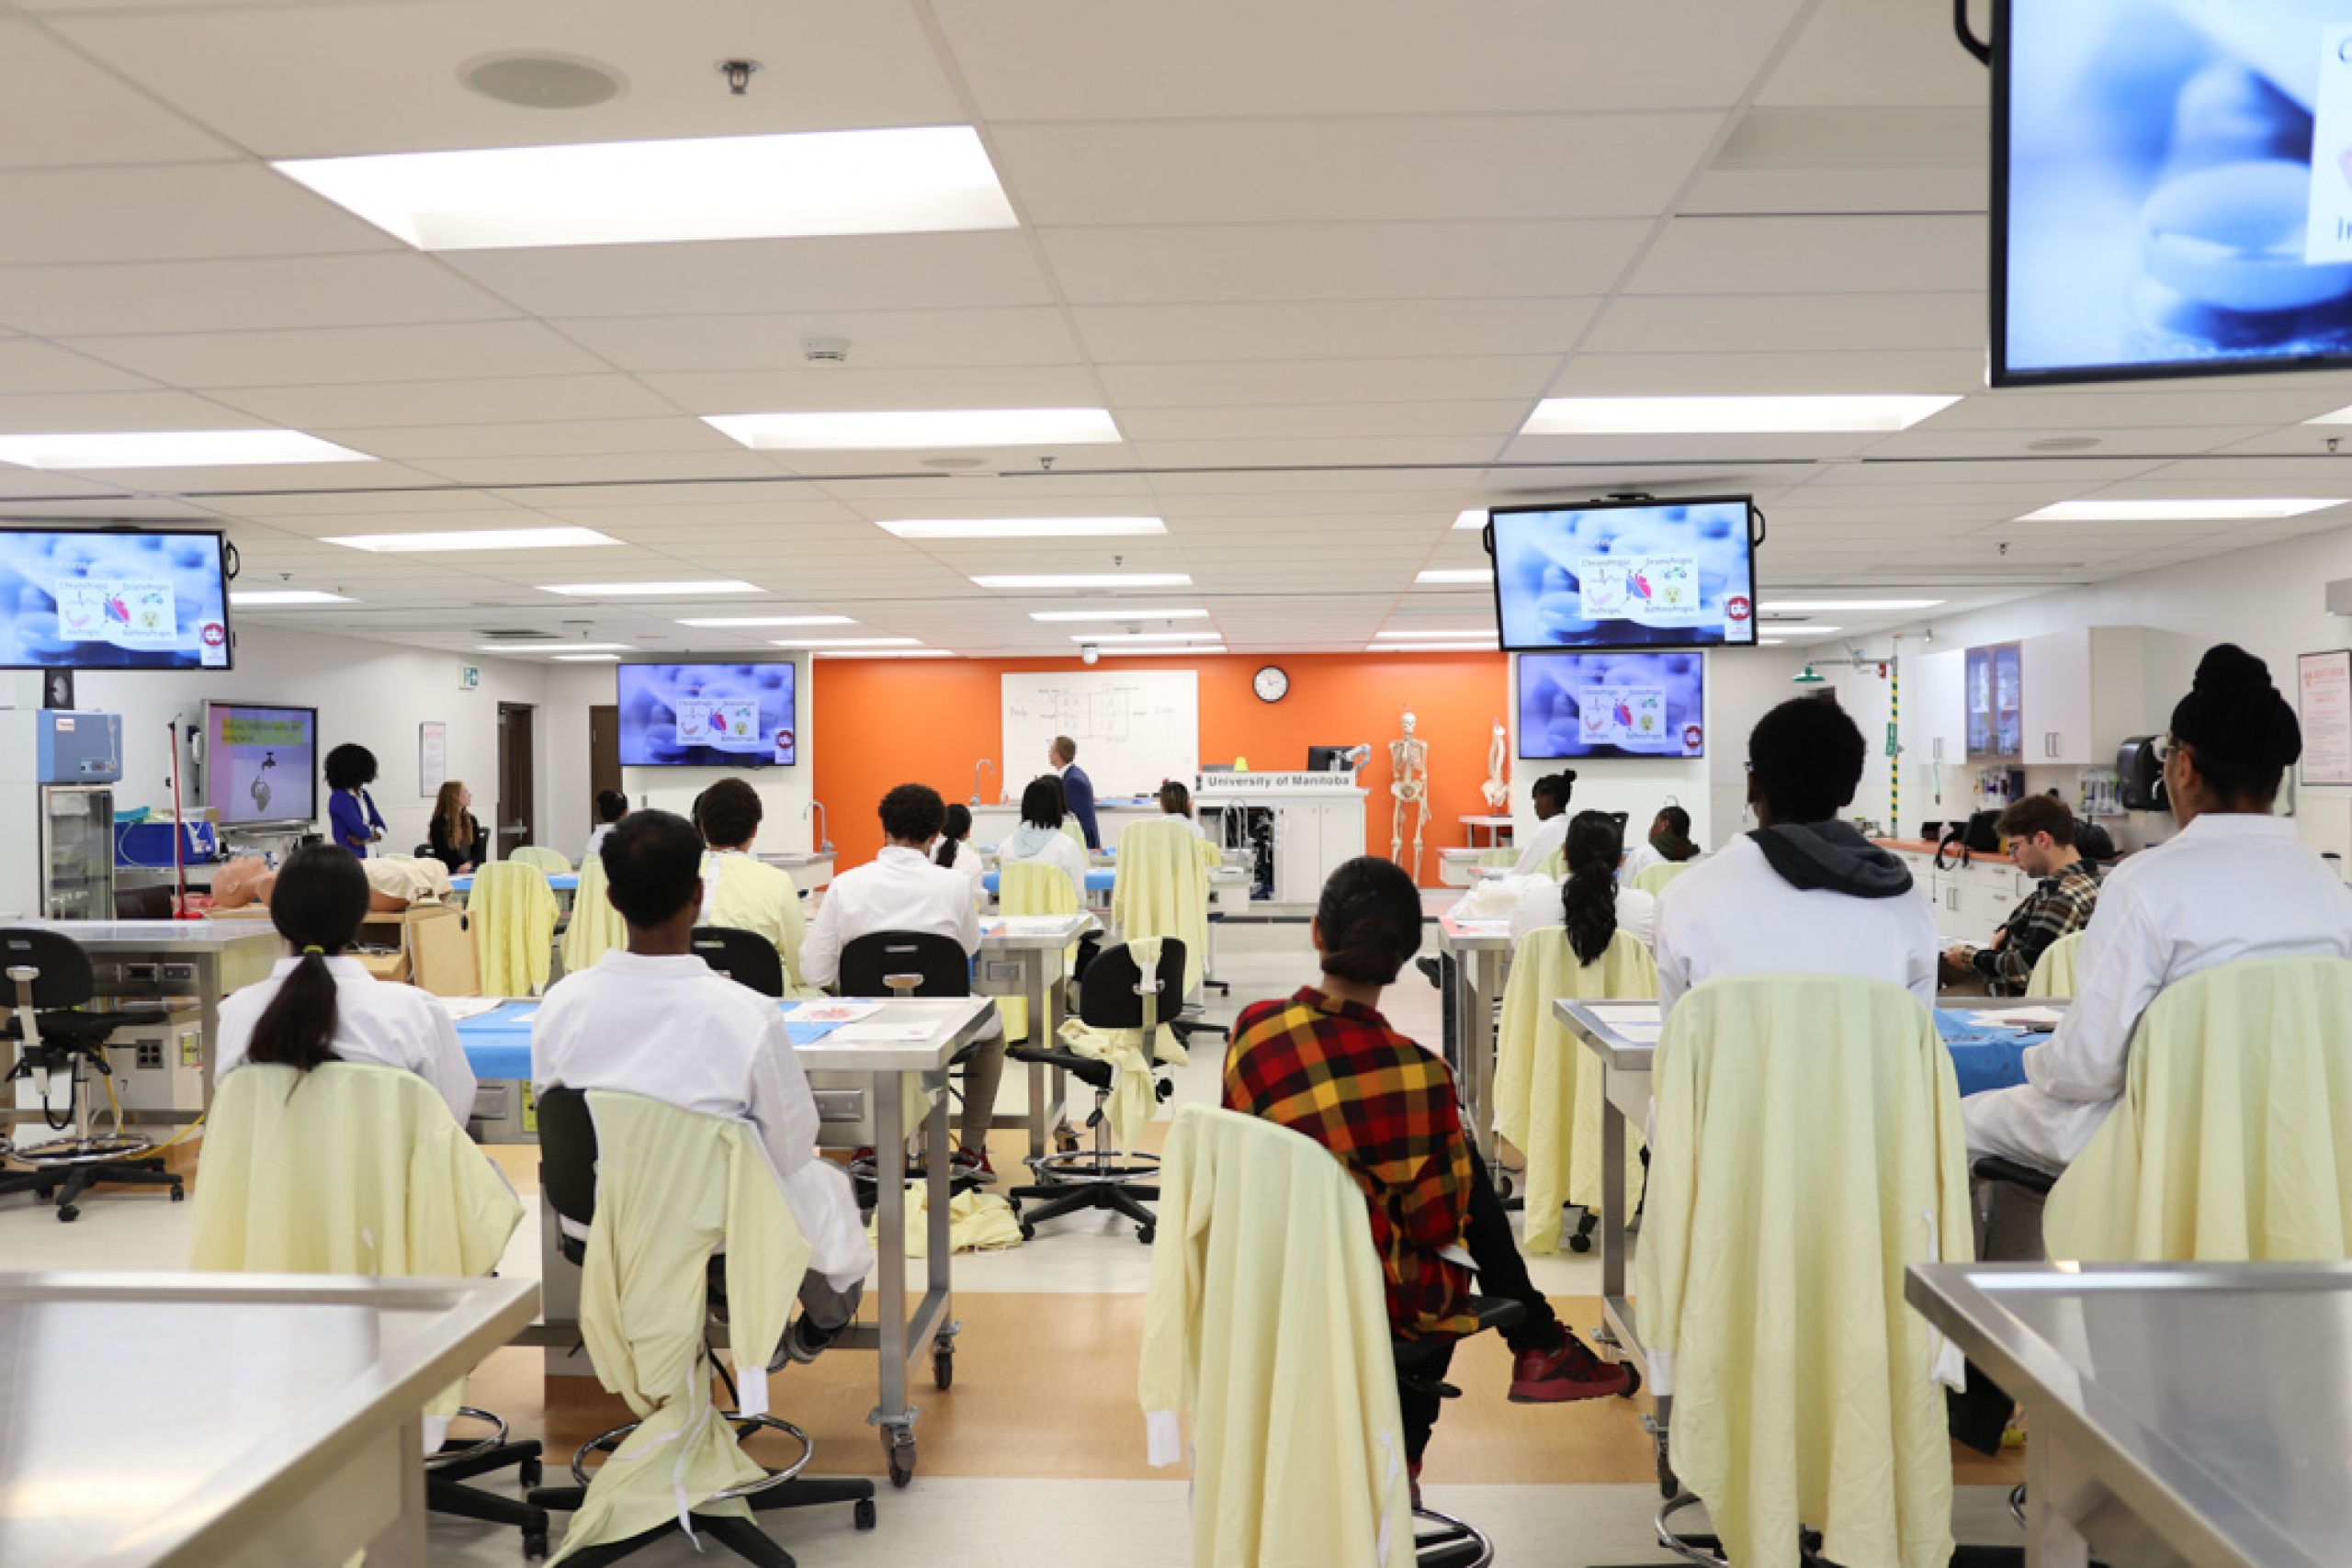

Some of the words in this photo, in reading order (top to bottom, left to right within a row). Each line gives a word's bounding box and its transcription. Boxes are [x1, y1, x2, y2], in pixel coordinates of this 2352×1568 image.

[1208, 775, 1272, 789] University
[1276, 775, 1288, 787] of
[1292, 775, 1350, 786] Manitoba
